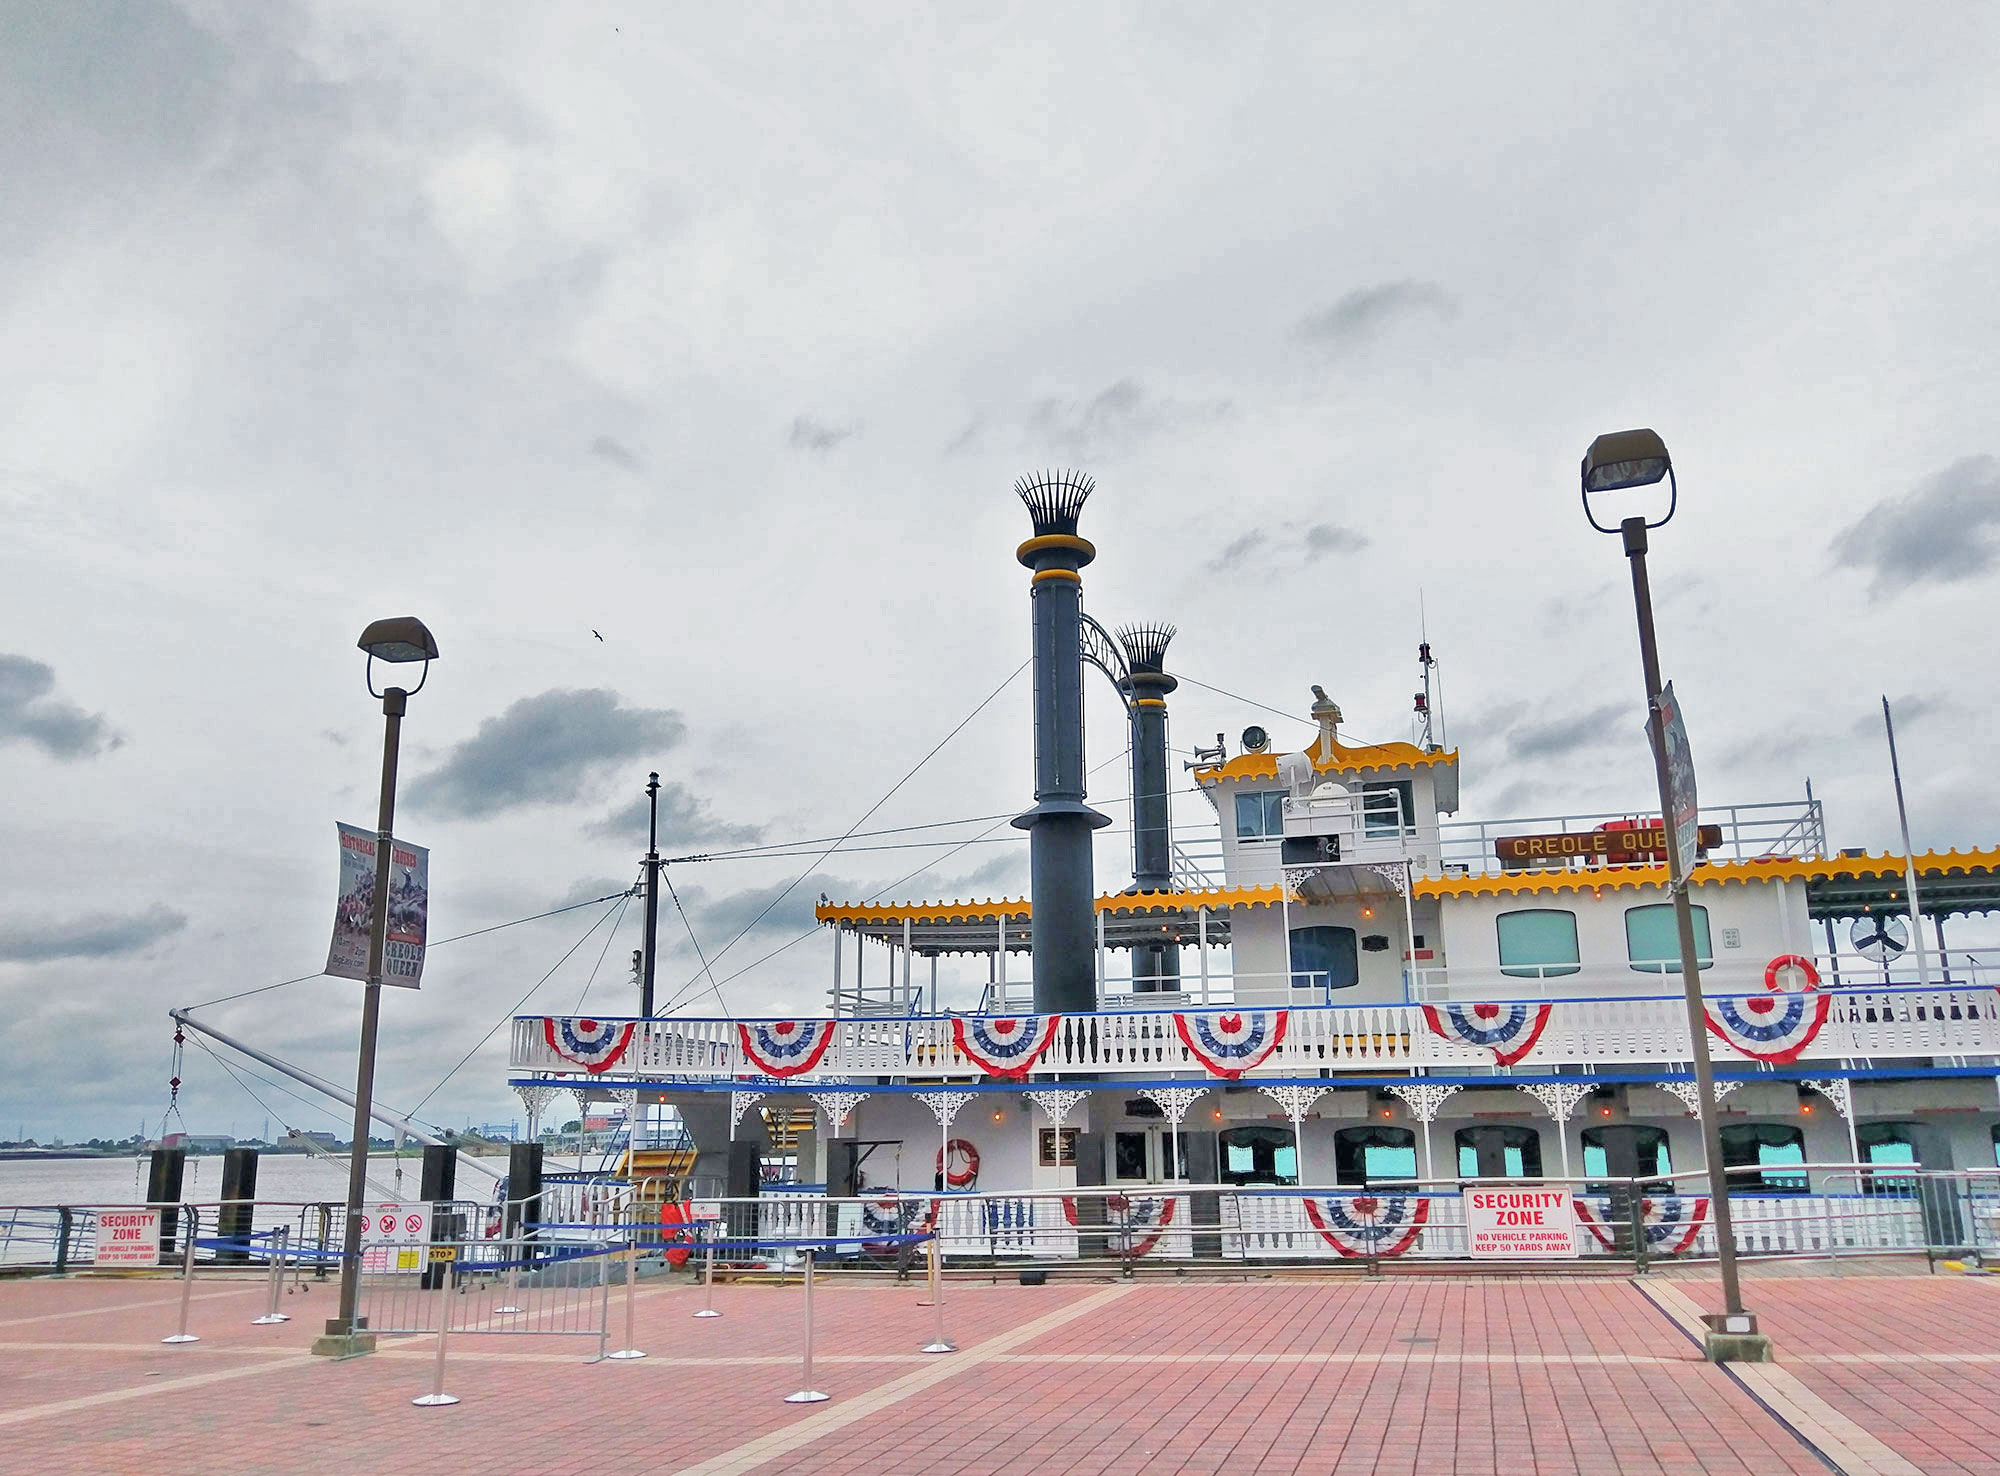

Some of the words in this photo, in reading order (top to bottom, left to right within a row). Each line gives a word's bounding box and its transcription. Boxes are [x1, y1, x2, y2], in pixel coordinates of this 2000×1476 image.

[1513, 835, 1607, 856] CREOLE
[385, 940, 424, 962] CREOLE
[386, 958, 419, 977] QUEEN
[1473, 1193, 1563, 1209] SECURITY
[101, 1215, 155, 1227] SECURITY
[1495, 1210, 1545, 1226] ZONE
[112, 1228, 141, 1240] ZONE
[1476, 1233, 1489, 1242] NO
[1491, 1233, 1527, 1241] VEHICLE
[1529, 1232, 1569, 1241] PARKING
[429, 1250, 452, 1259] STOP
[1475, 1243, 1498, 1252] KEEP
[1500, 1243, 1512, 1252] 50
[1513, 1243, 1543, 1252] YARDS
[1545, 1243, 1572, 1251] AWAY
